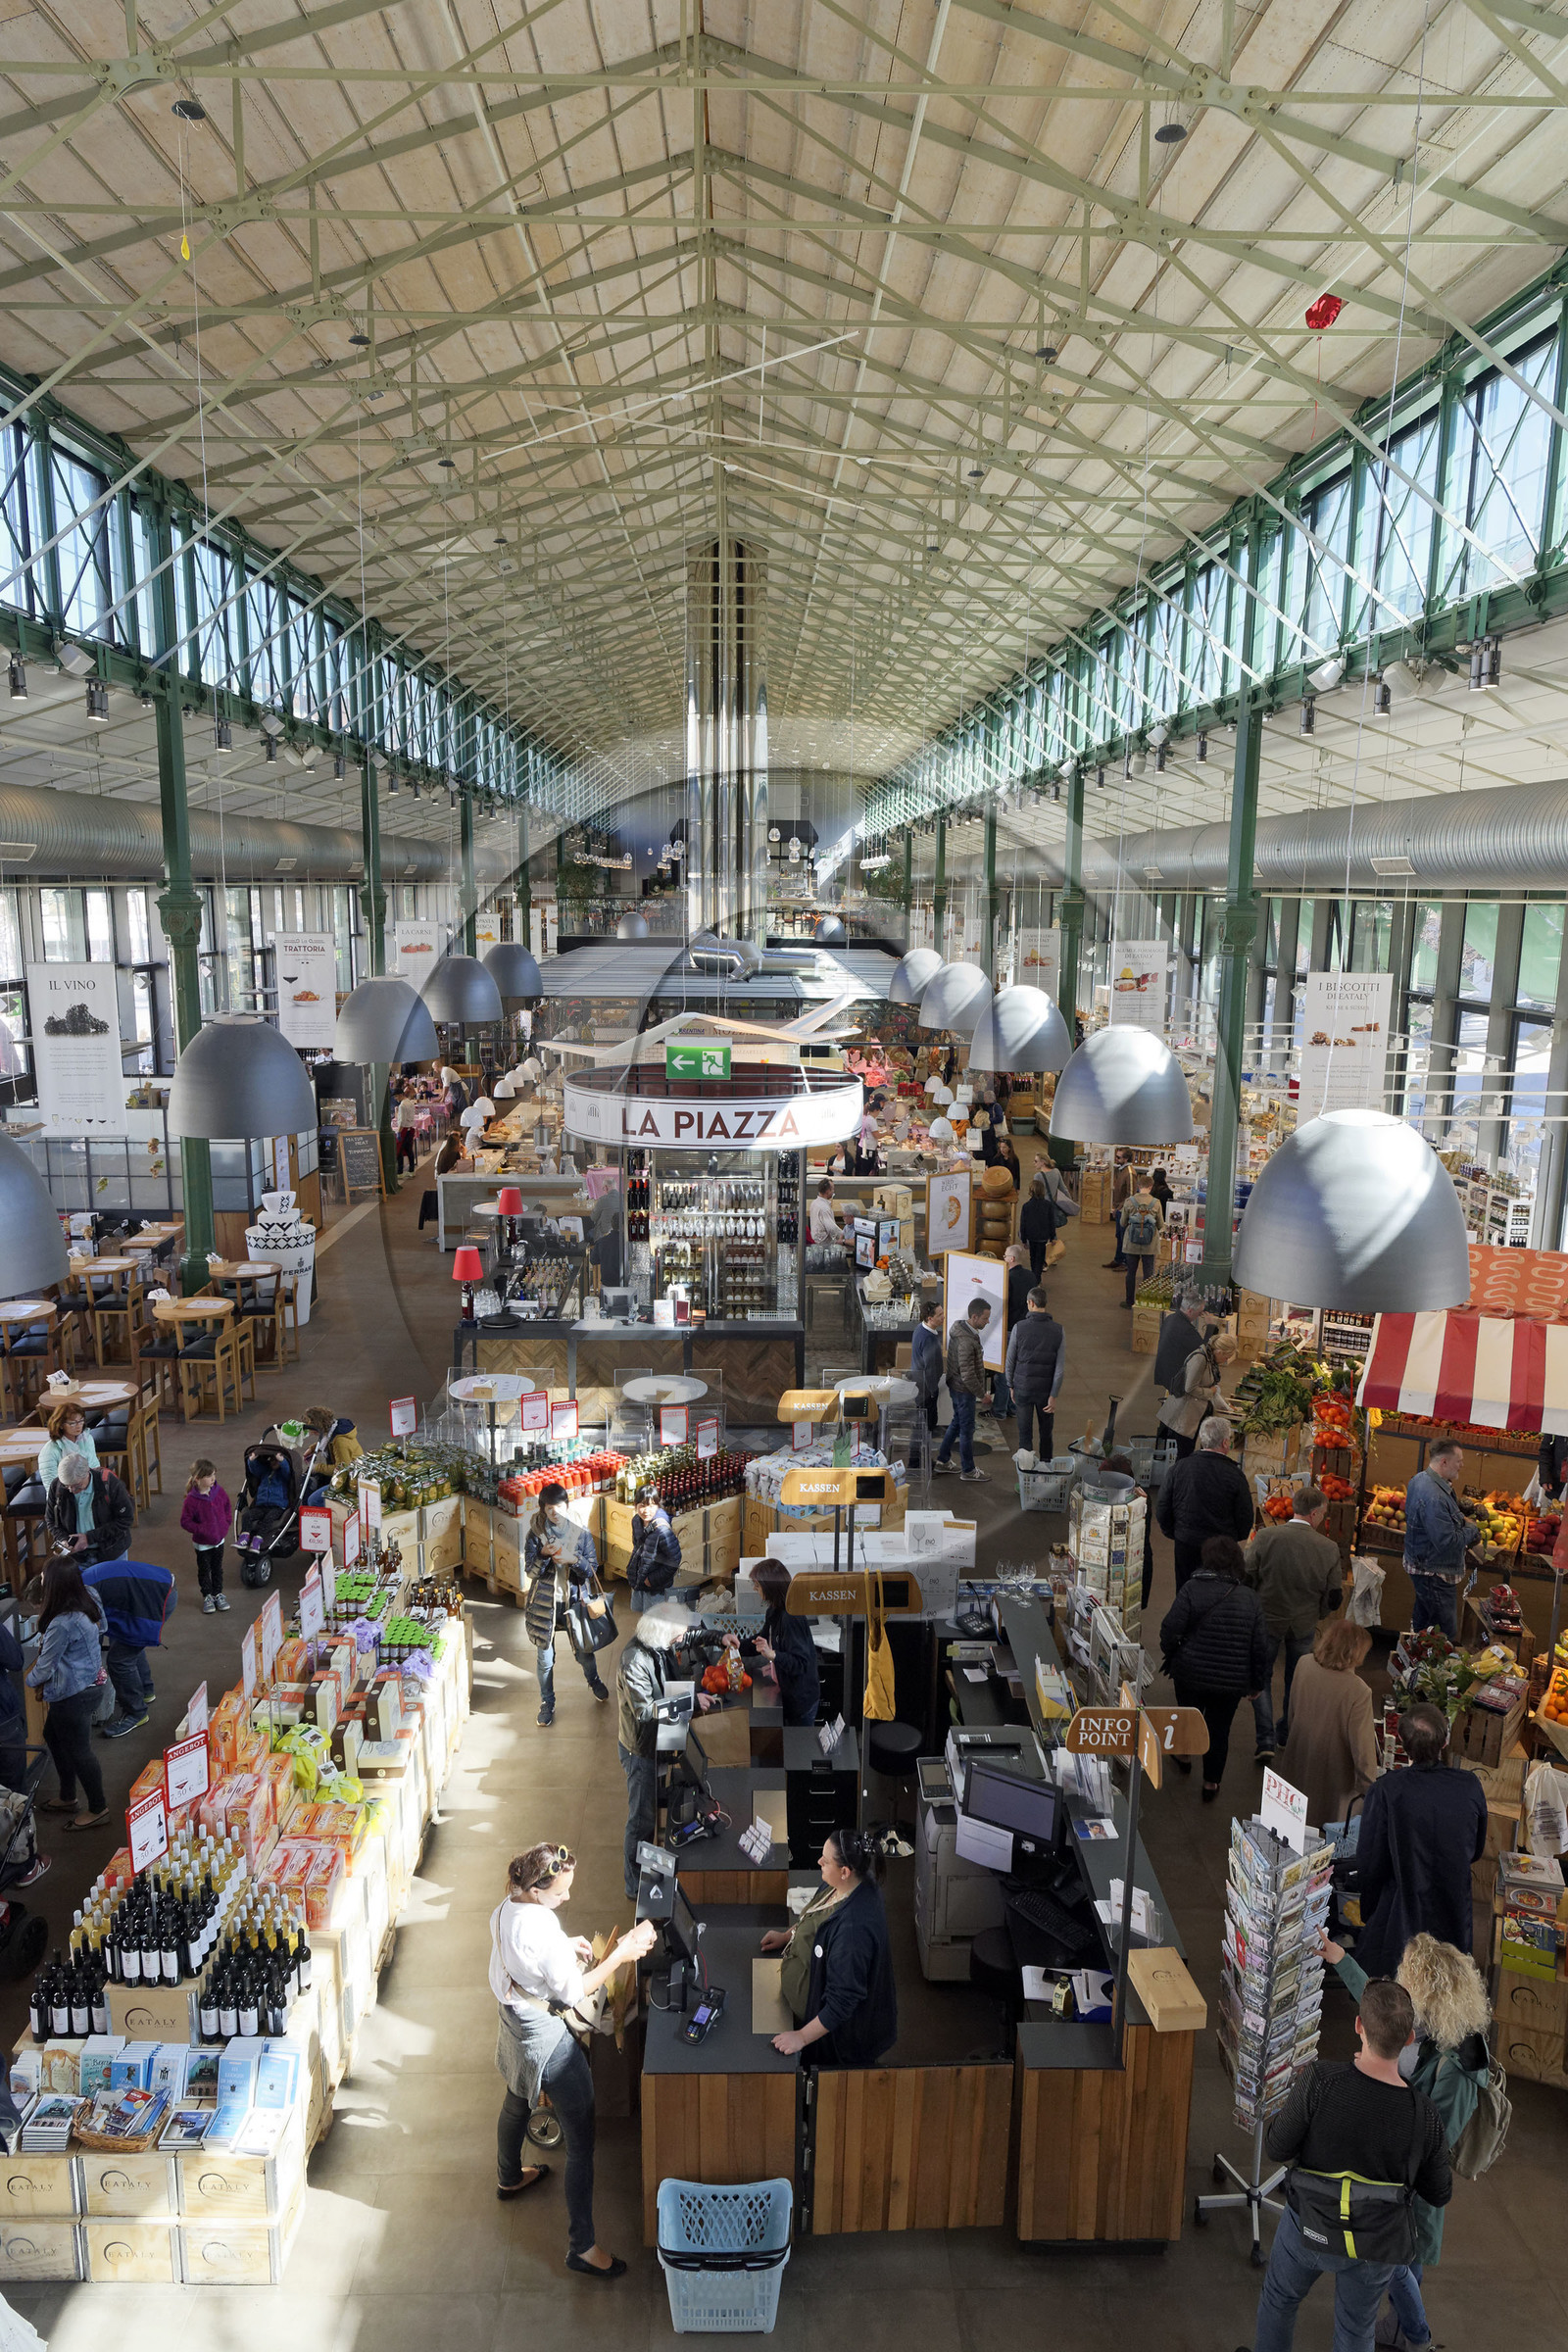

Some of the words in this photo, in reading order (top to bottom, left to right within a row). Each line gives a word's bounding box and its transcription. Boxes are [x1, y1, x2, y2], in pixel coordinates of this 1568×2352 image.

[49, 980, 61, 991] IL
[64, 980, 96, 991] VINO
[1318, 982, 1322, 991] I
[1326, 982, 1380, 992] BISCOTTI
[621, 1107, 661, 1138] LA
[674, 1109, 801, 1140] PIAZZA
[800, 1483, 840, 1493] KASSEN
[809, 1591, 857, 1601] KASSEN
[1079, 1717, 1132, 1732] INFO
[1163, 1713, 1178, 1750] i
[1078, 1732, 1131, 1746] POINT
[168, 1738, 206, 1761] ANGEBOT
[188, 1784, 195, 1792] €
[129, 1792, 163, 1822] ANGEBOT
[150, 1843, 156, 1853] €
